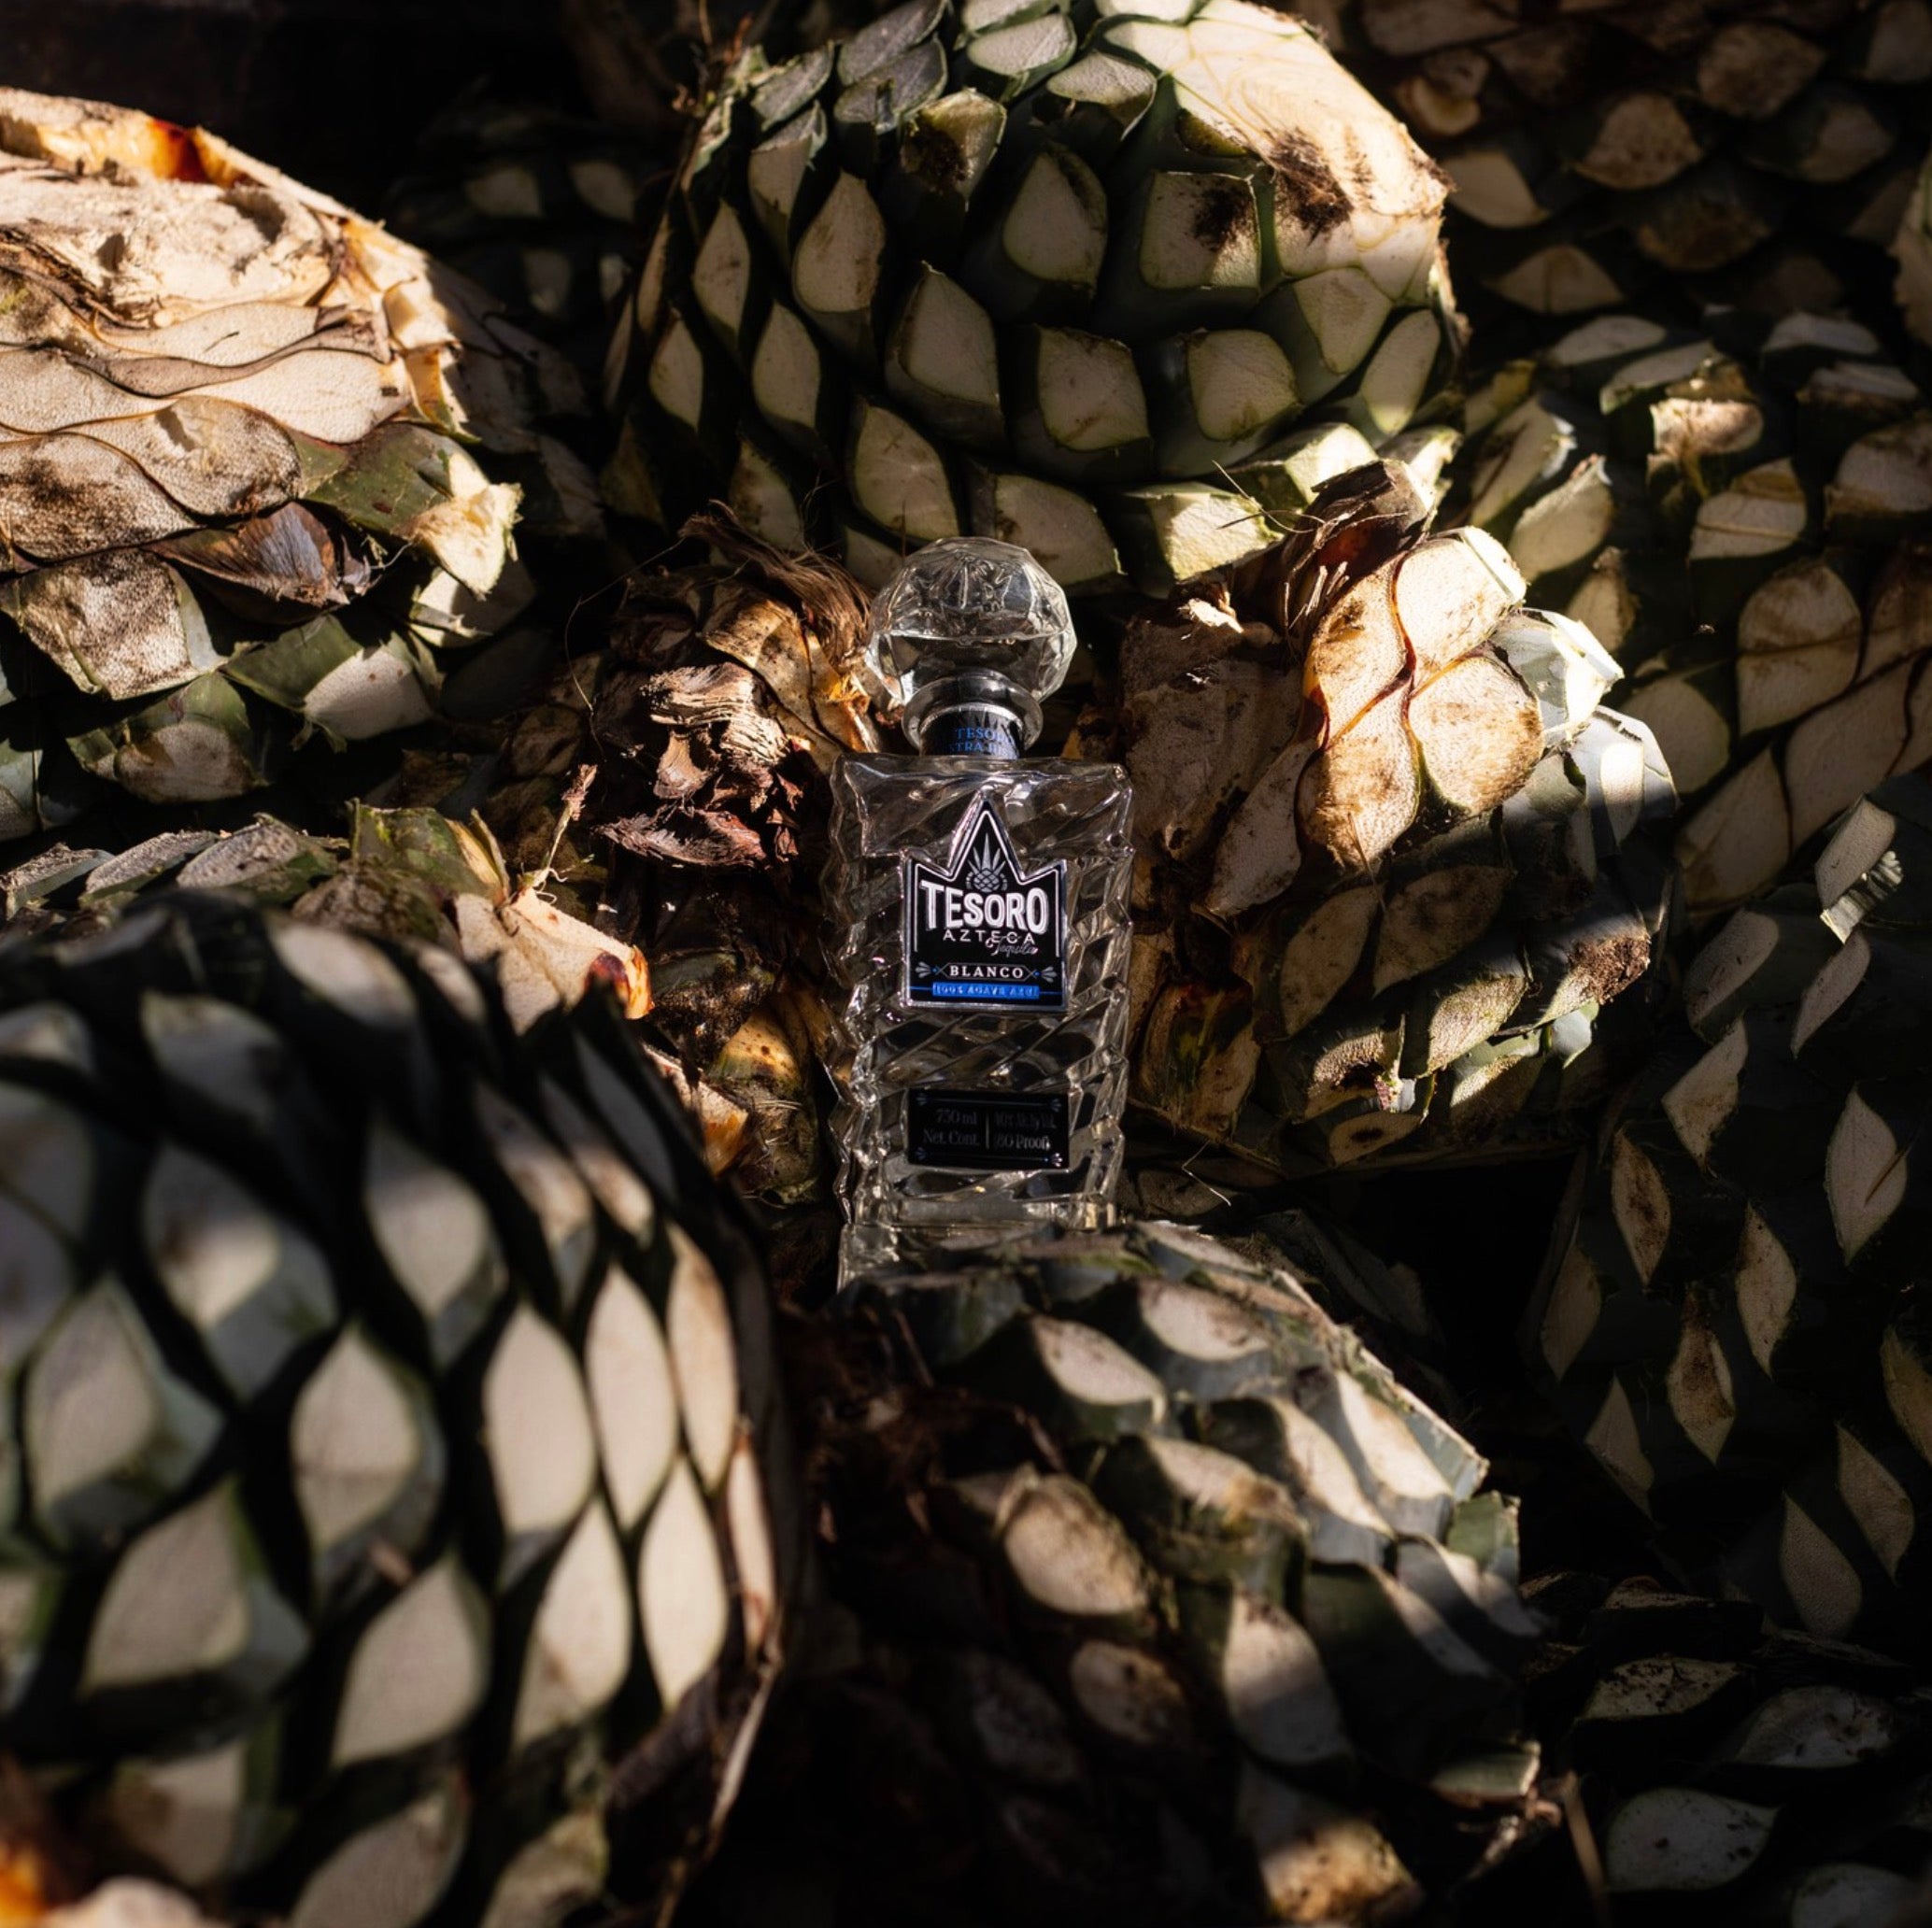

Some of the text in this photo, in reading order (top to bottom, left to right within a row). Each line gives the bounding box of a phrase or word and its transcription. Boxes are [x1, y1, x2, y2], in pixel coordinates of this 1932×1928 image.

[919, 879, 1049, 934] TESORO
[943, 929, 1035, 944] AZTECA
[949, 965, 1024, 979] BLANCO
